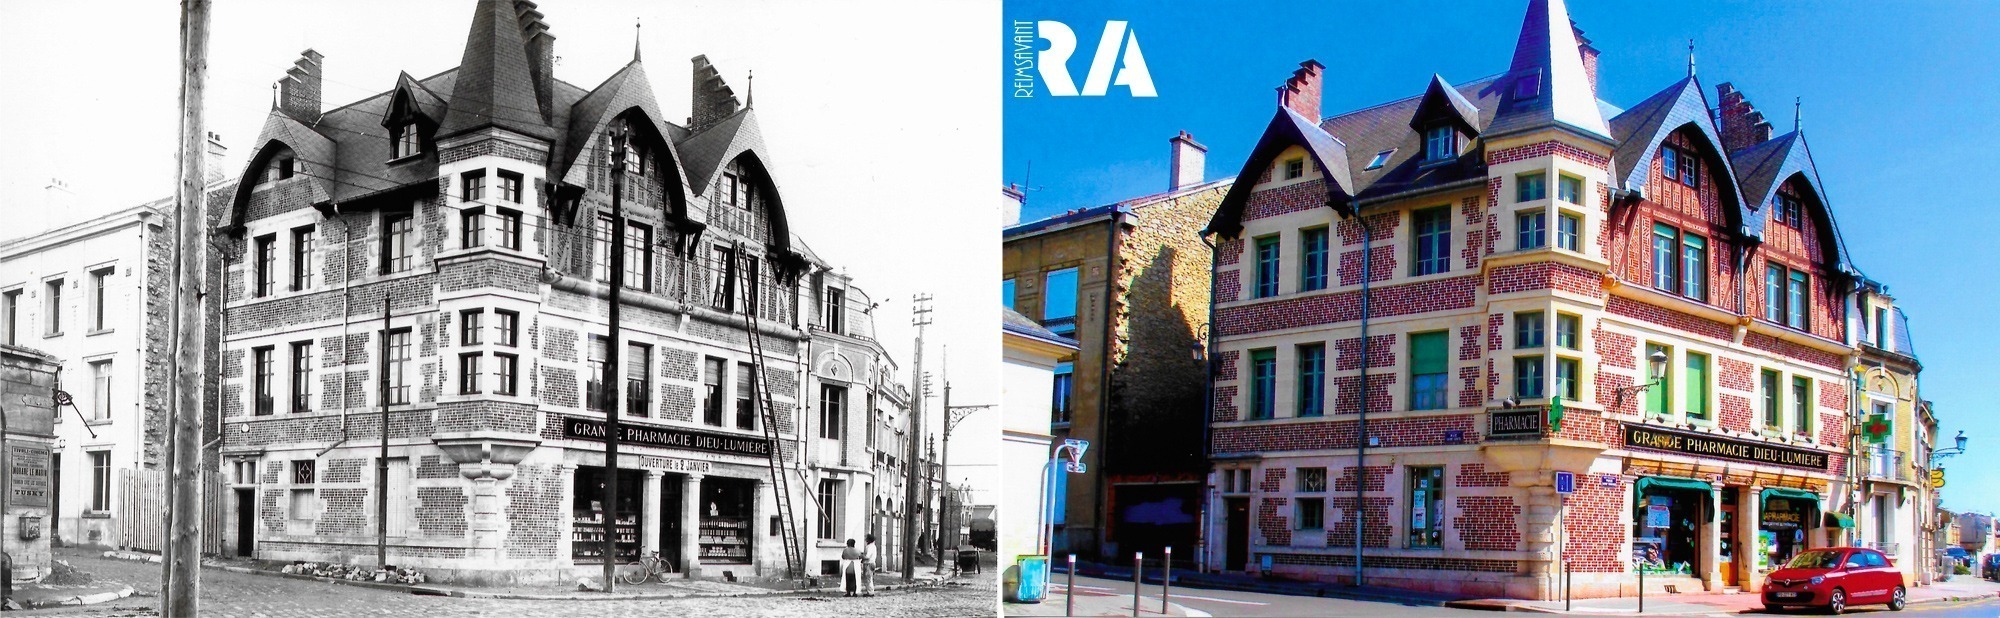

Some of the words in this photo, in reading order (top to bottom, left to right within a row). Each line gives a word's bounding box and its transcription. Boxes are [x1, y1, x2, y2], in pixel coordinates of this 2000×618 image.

[1494, 415, 1538, 430] PHARMACIE
[574, 422, 622, 440] GRANE
[627, 428, 691, 446] PHARMACIE
[1687, 438, 1749, 458] PHARMACIE
[641, 455, 673, 469] OUVERTURE
[680, 460, 685, 470] 2
[686, 461, 710, 472] JANVIER
[15, 489, 44, 497] TUSKY
